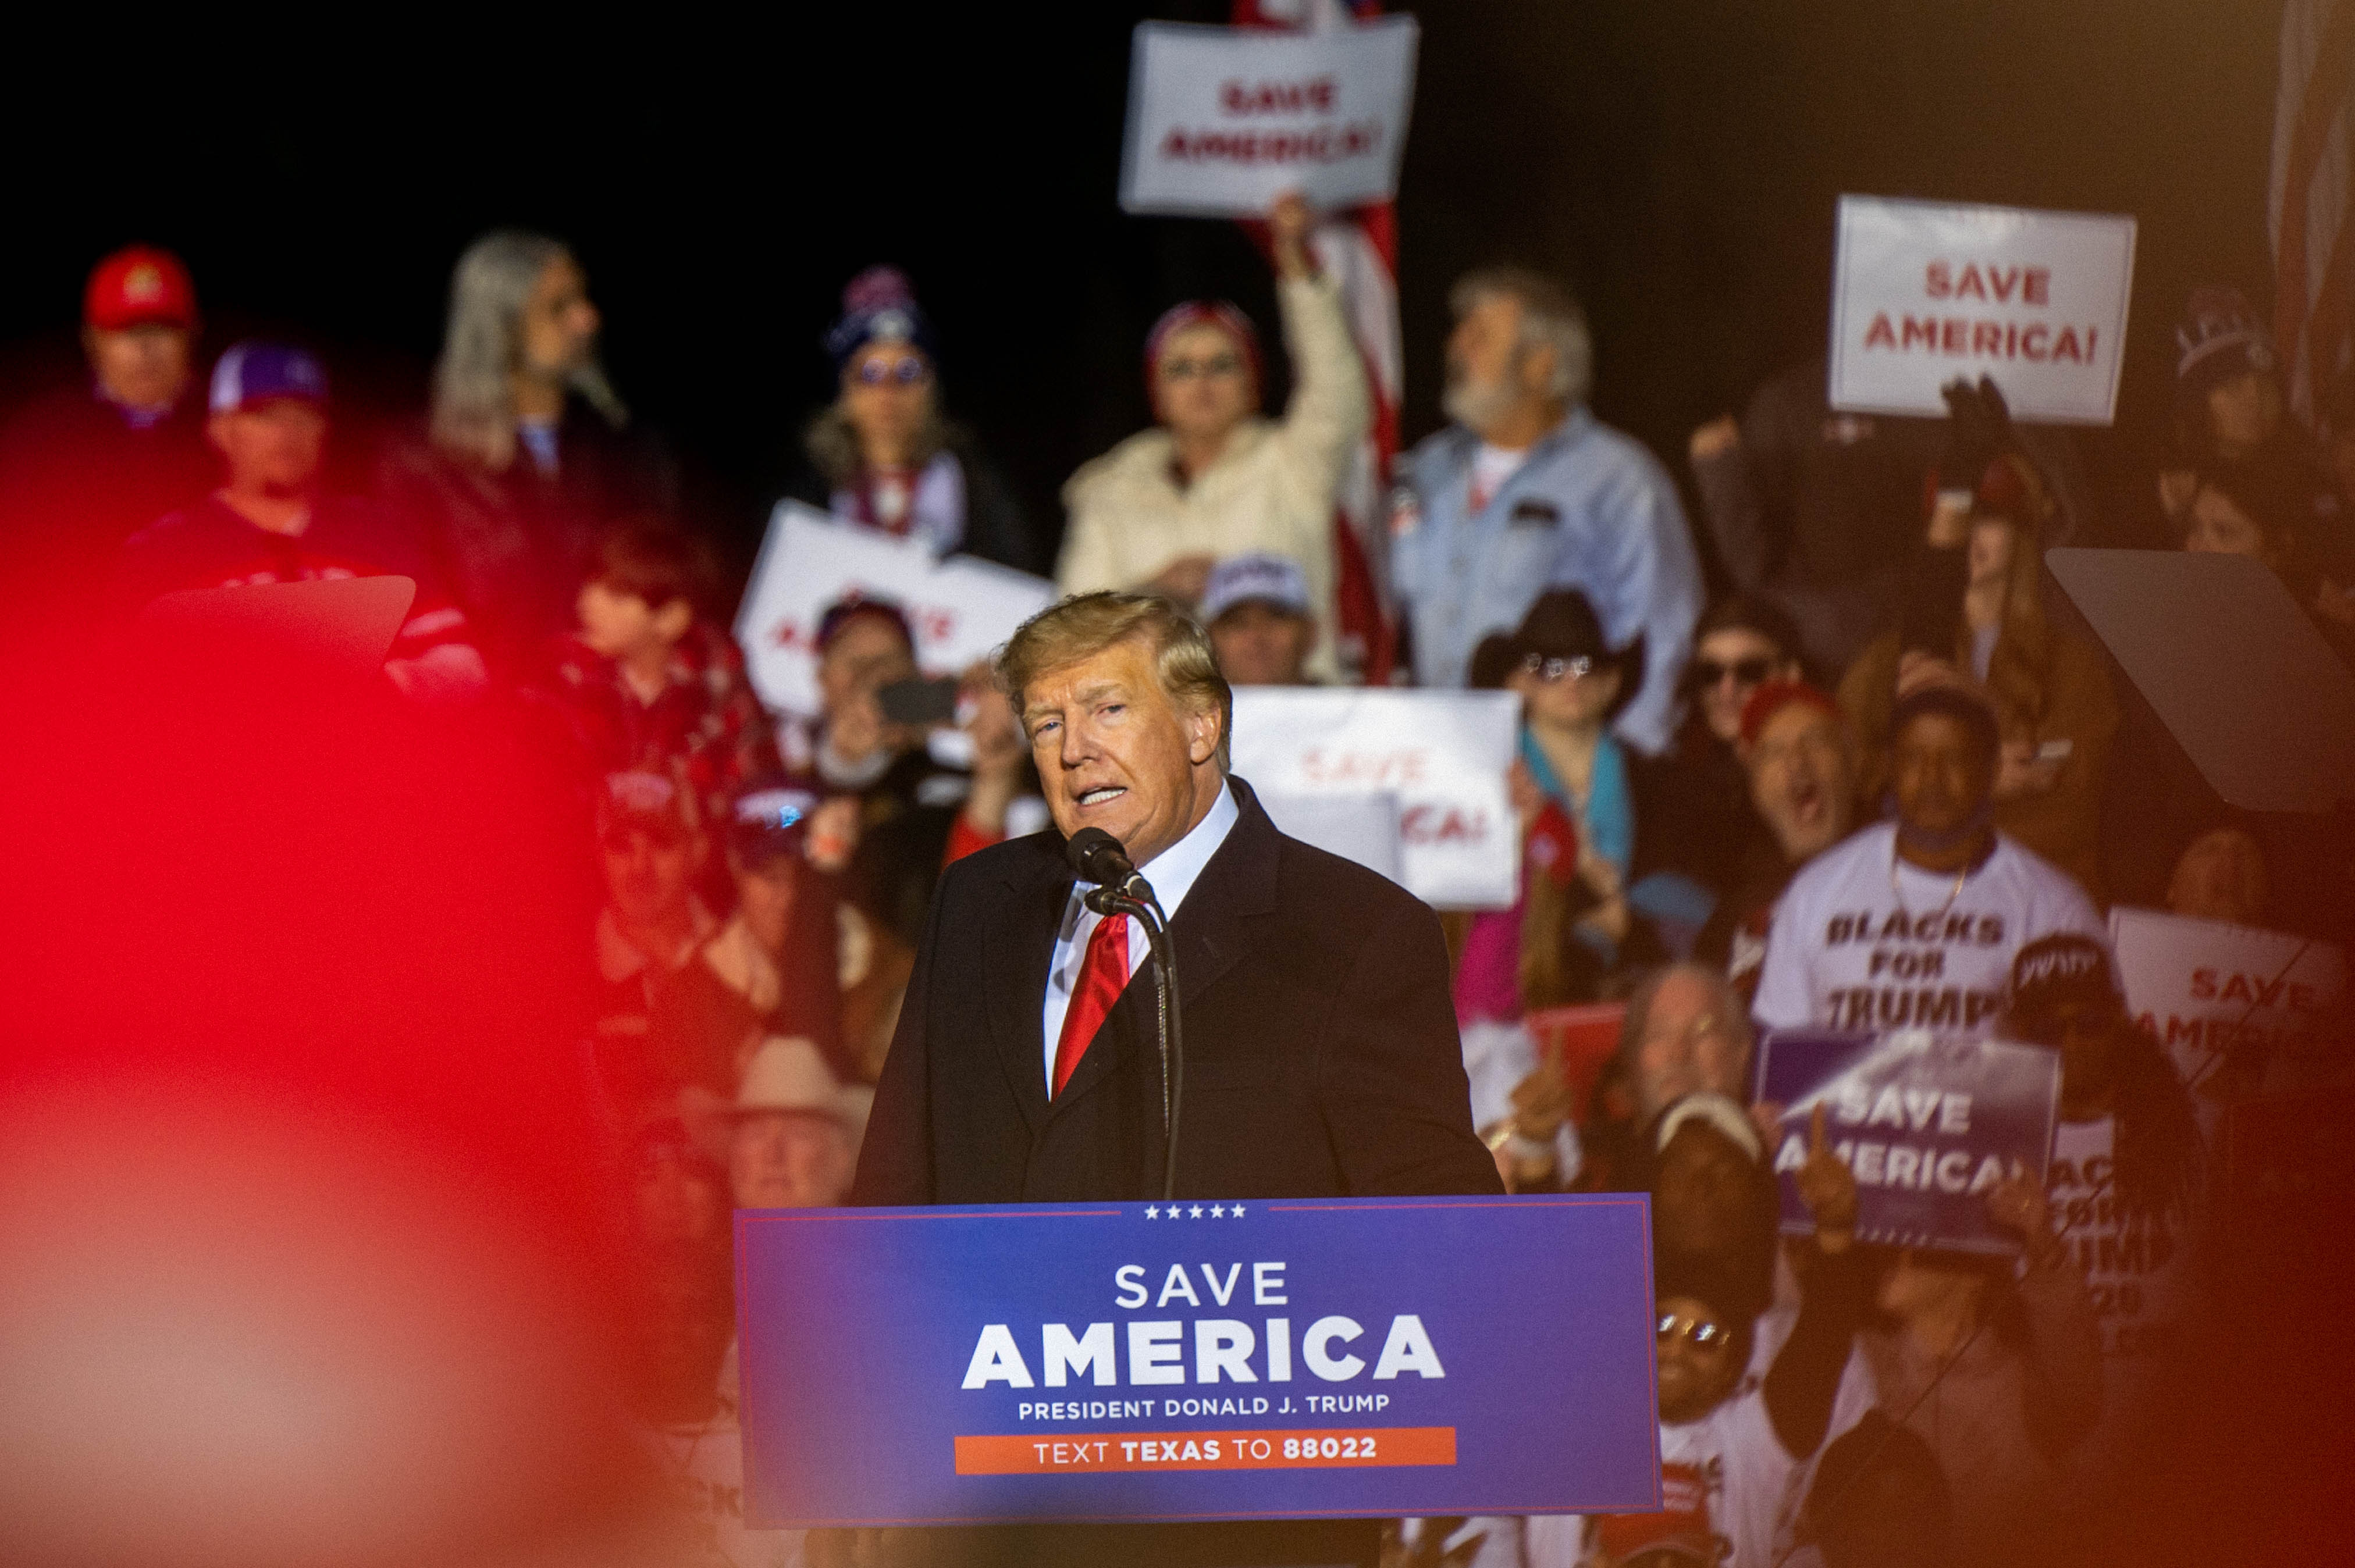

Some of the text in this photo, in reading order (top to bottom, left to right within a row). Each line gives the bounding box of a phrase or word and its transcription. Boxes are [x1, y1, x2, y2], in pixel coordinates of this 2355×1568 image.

[1924, 259, 2051, 307] SAVE
[1865, 312, 2097, 366] AMERICA!
[1826, 907, 2004, 948] BLACKS
[1868, 949, 1946, 980] FOR
[2190, 966, 2318, 1013] SAVE
[1837, 1082, 1974, 1135] SAVE
[1114, 1261, 1289, 1309] SAVE
[961, 1314, 1445, 1389] AMERICA
[1019, 1395, 1390, 1420] PRESIDENT DONALD J. TRUMP
[1033, 1437, 1377, 1464] TEXT TEXAS TO 88022
